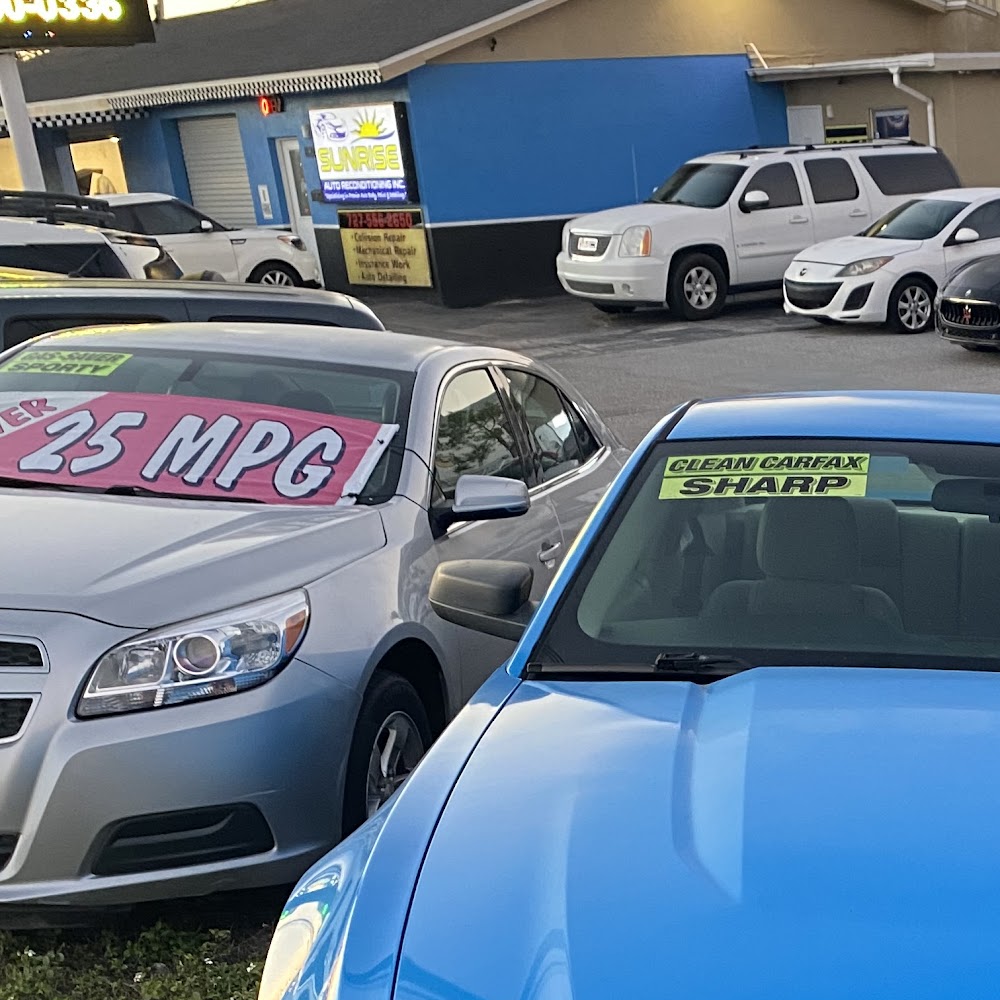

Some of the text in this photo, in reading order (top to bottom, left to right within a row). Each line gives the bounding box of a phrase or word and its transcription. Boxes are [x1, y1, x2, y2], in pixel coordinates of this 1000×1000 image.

[318, 144, 400, 172] SUNRISE
[324, 181, 340, 190] AUTO
[383, 233, 406, 243] Repair
[356, 246, 417, 257] Mechanical Repair
[358, 259, 411, 270] Insurance Work
[361, 272, 407, 284] Auto Detailing
[7, 362, 112, 373] SPORTY
[0, 397, 57, 435] ER
[17, 409, 347, 499] 25 MPG
[669, 455, 868, 473] CLEAN CARFAX
[679, 476, 852, 497] SHARP
